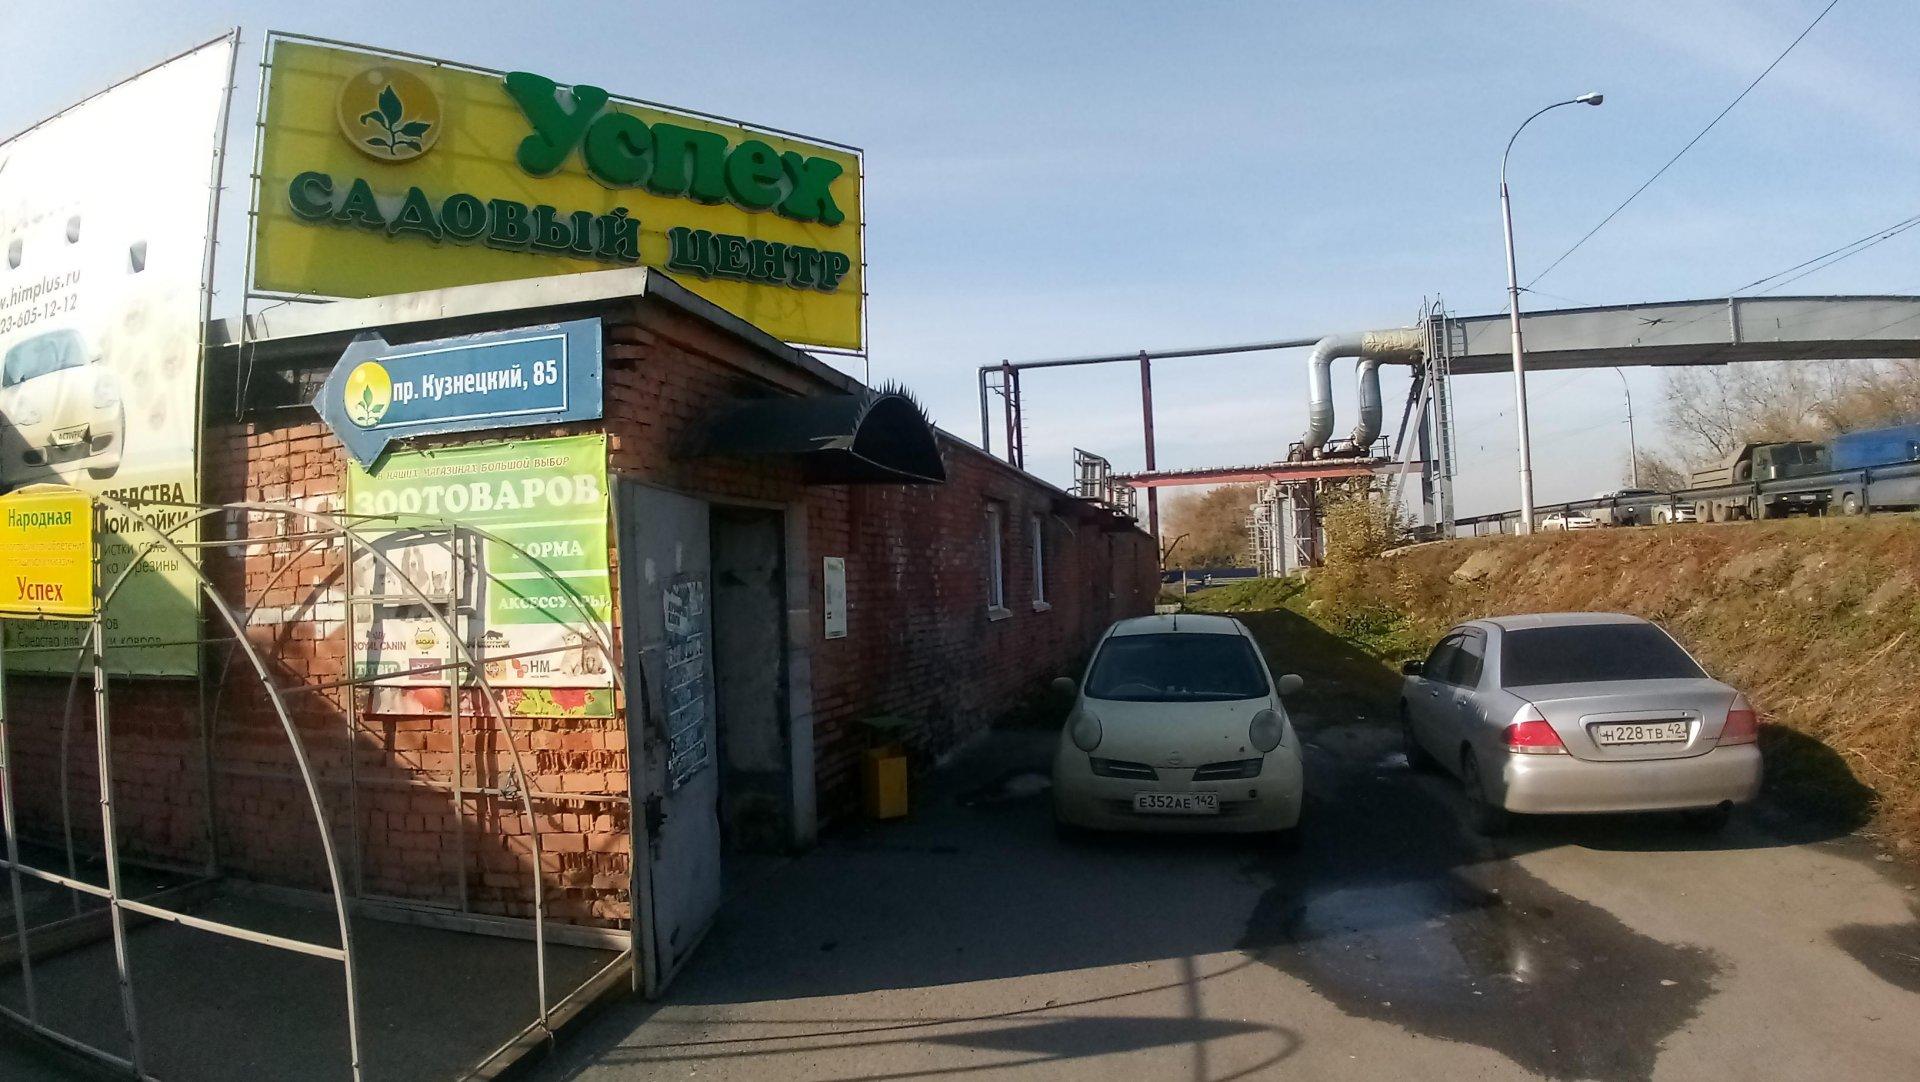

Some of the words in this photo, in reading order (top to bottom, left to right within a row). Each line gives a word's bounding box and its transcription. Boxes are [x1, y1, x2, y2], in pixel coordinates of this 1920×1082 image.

[502, 70, 846, 227] Успех
[288, 171, 641, 263] САДОВЫЙ
[667, 225, 852, 293] ЦЕНТР
[393, 382, 419, 405] пр.
[422, 364, 528, 401] Кузнецкий,
[533, 359, 558, 386] 85
[423, 464, 478, 478] МАГАЗИНАХ
[481, 457, 530, 473] БОЛЬШОЙ
[534, 456, 570, 468] ВЫБОР
[355, 474, 600, 514] ЗООТОВАРОВ
[8, 508, 72, 531] Народная
[16, 576, 64, 602] Успех
[1139, 795, 1191, 809] Е352АЕ
[1194, 795, 1214, 806] 142
